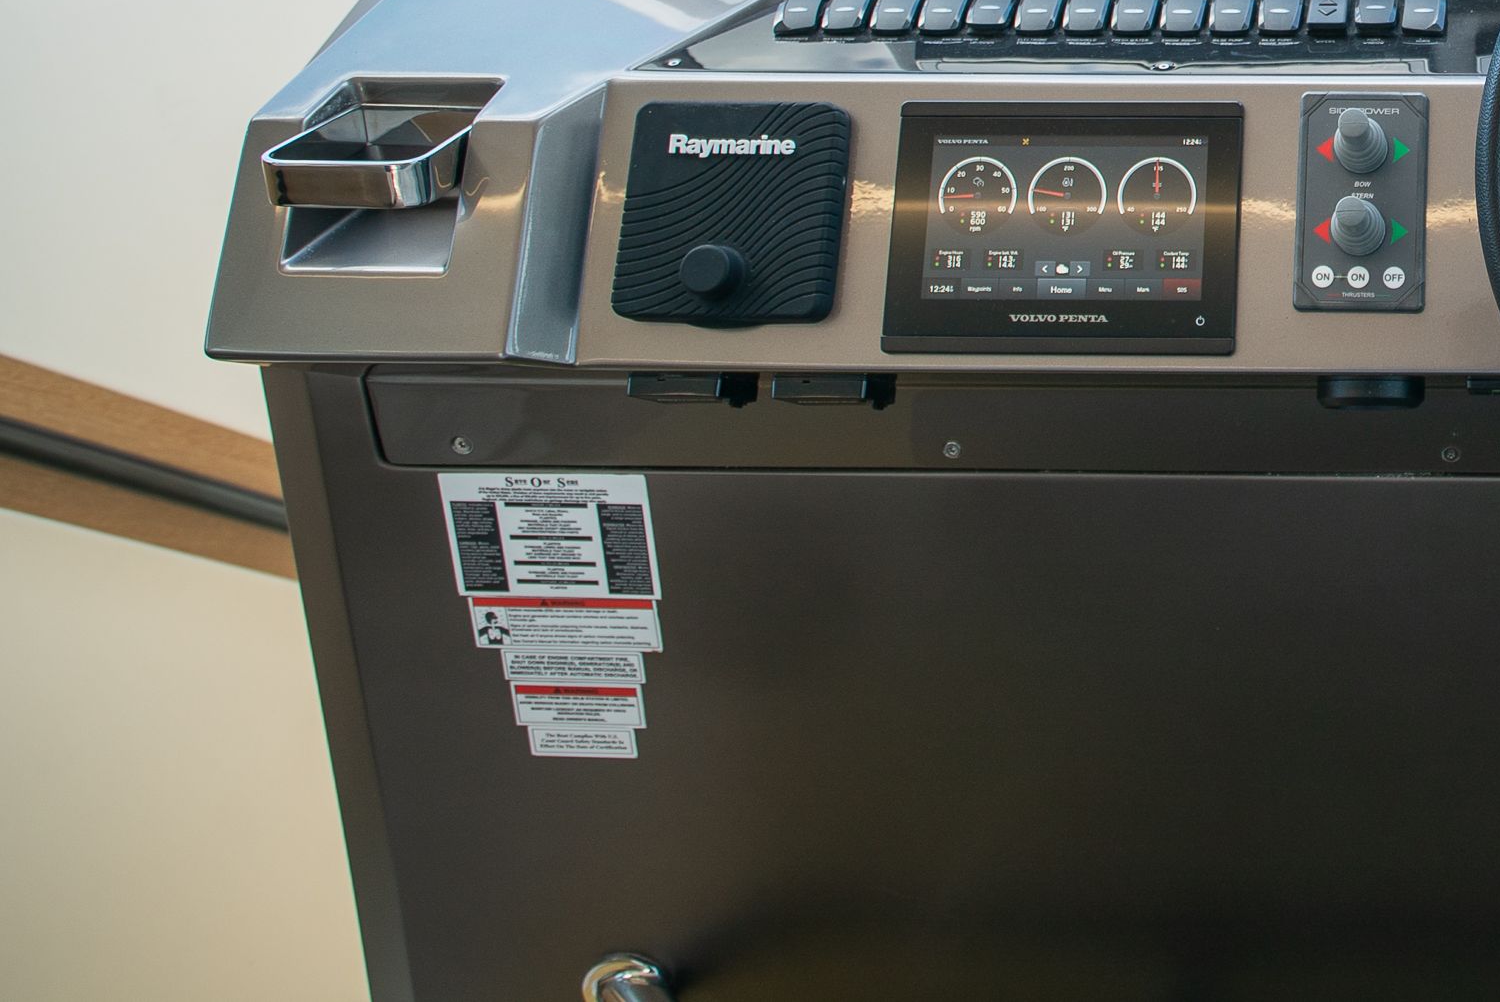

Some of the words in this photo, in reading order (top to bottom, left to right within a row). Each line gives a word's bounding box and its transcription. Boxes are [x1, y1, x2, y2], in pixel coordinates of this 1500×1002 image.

[668, 134, 796, 158] Raymarine
[1009, 314, 1056, 322] VOLVO
[1059, 314, 1108, 322] PENTA
